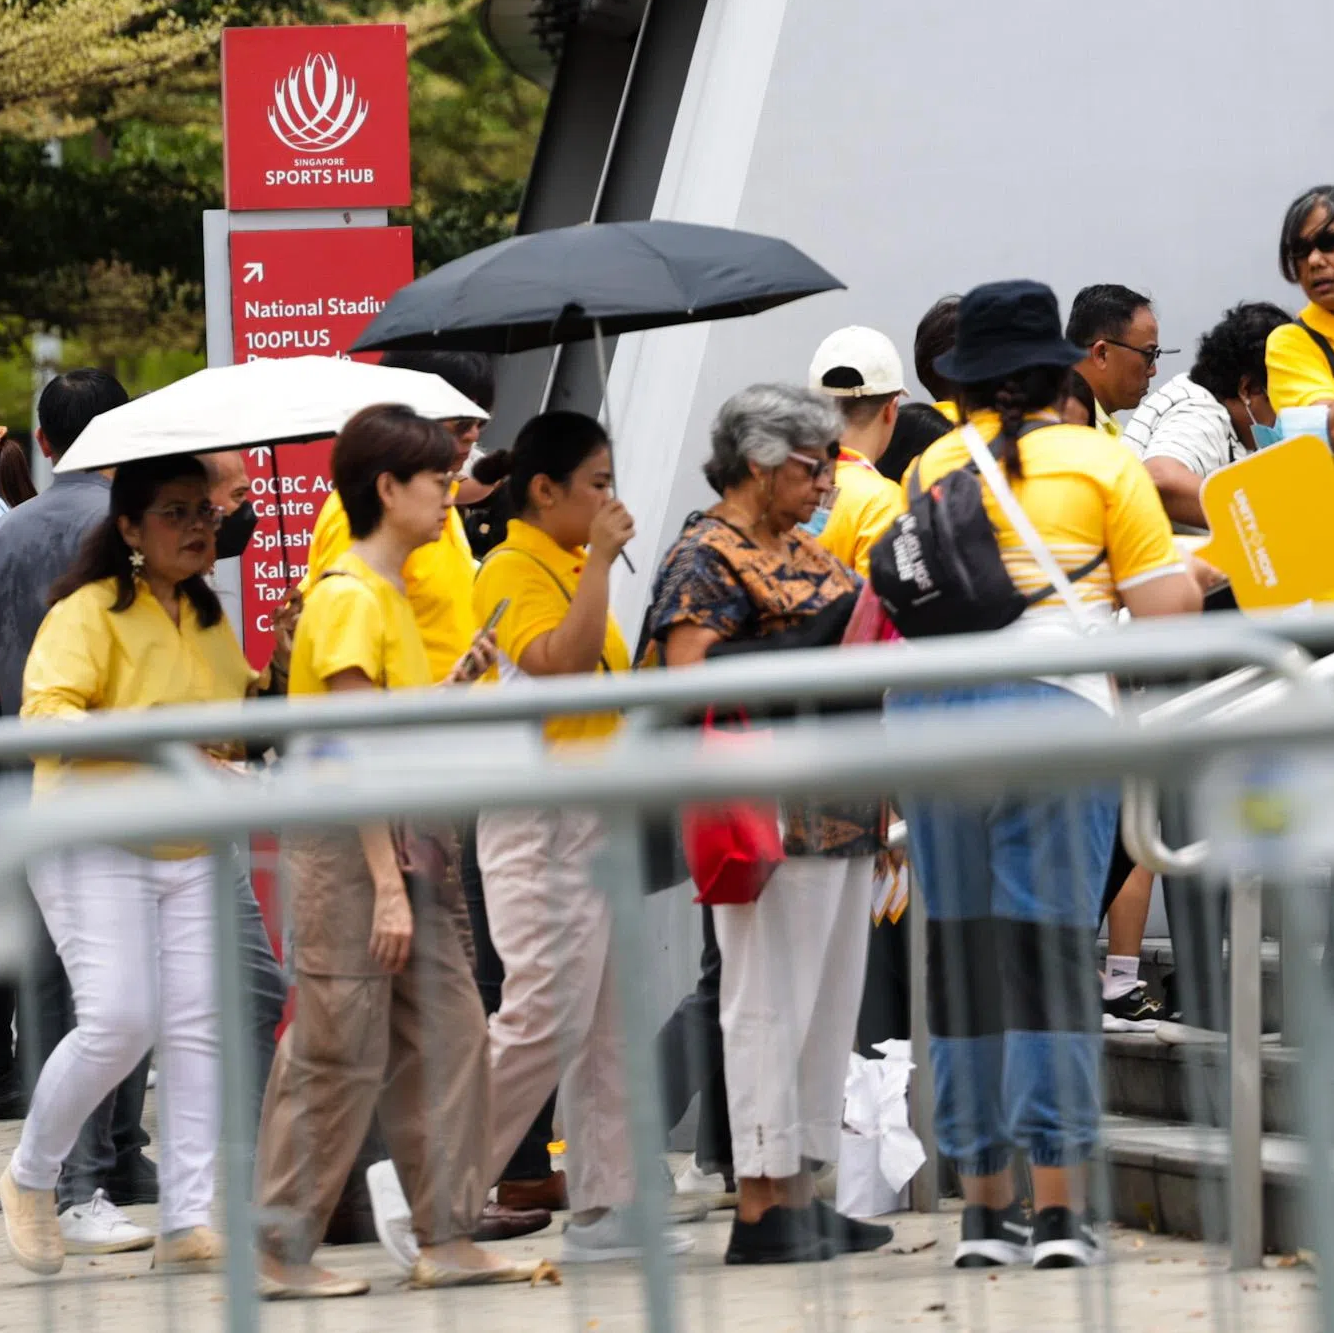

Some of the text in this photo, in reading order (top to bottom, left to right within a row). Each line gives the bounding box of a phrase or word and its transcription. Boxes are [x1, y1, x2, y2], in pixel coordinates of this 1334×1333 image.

[293, 157, 345, 167] SINGAPORE
[265, 168, 374, 185] SPORTS HUB
[244, 295, 386, 319] National Stadiu
[244, 328, 331, 350] 100PLUS
[253, 583, 287, 602] Tax
